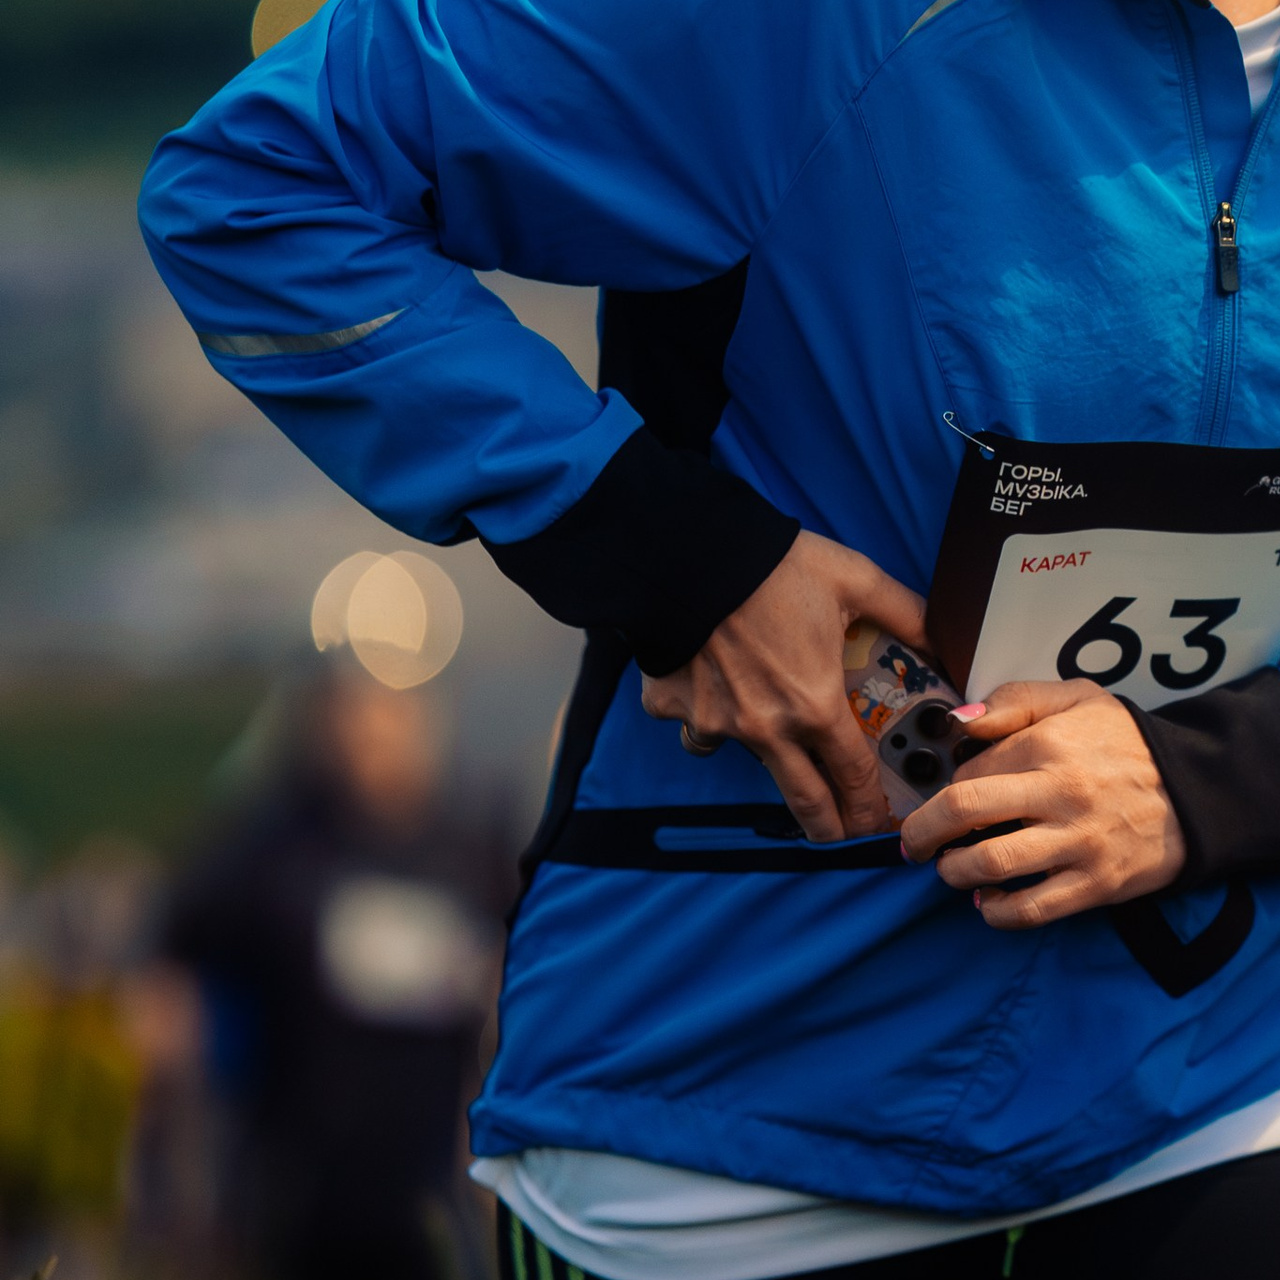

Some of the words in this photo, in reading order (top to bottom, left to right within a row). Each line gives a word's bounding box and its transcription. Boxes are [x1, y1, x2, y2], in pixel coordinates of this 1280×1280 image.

[999, 461, 1064, 483] ГОРЫ.
[994, 479, 1089, 500] МУЗЫКА.
[989, 496, 1033, 516] БЕГ
[1020, 550, 1092, 573] КАРАТ
[1056, 596, 1241, 690] 63
